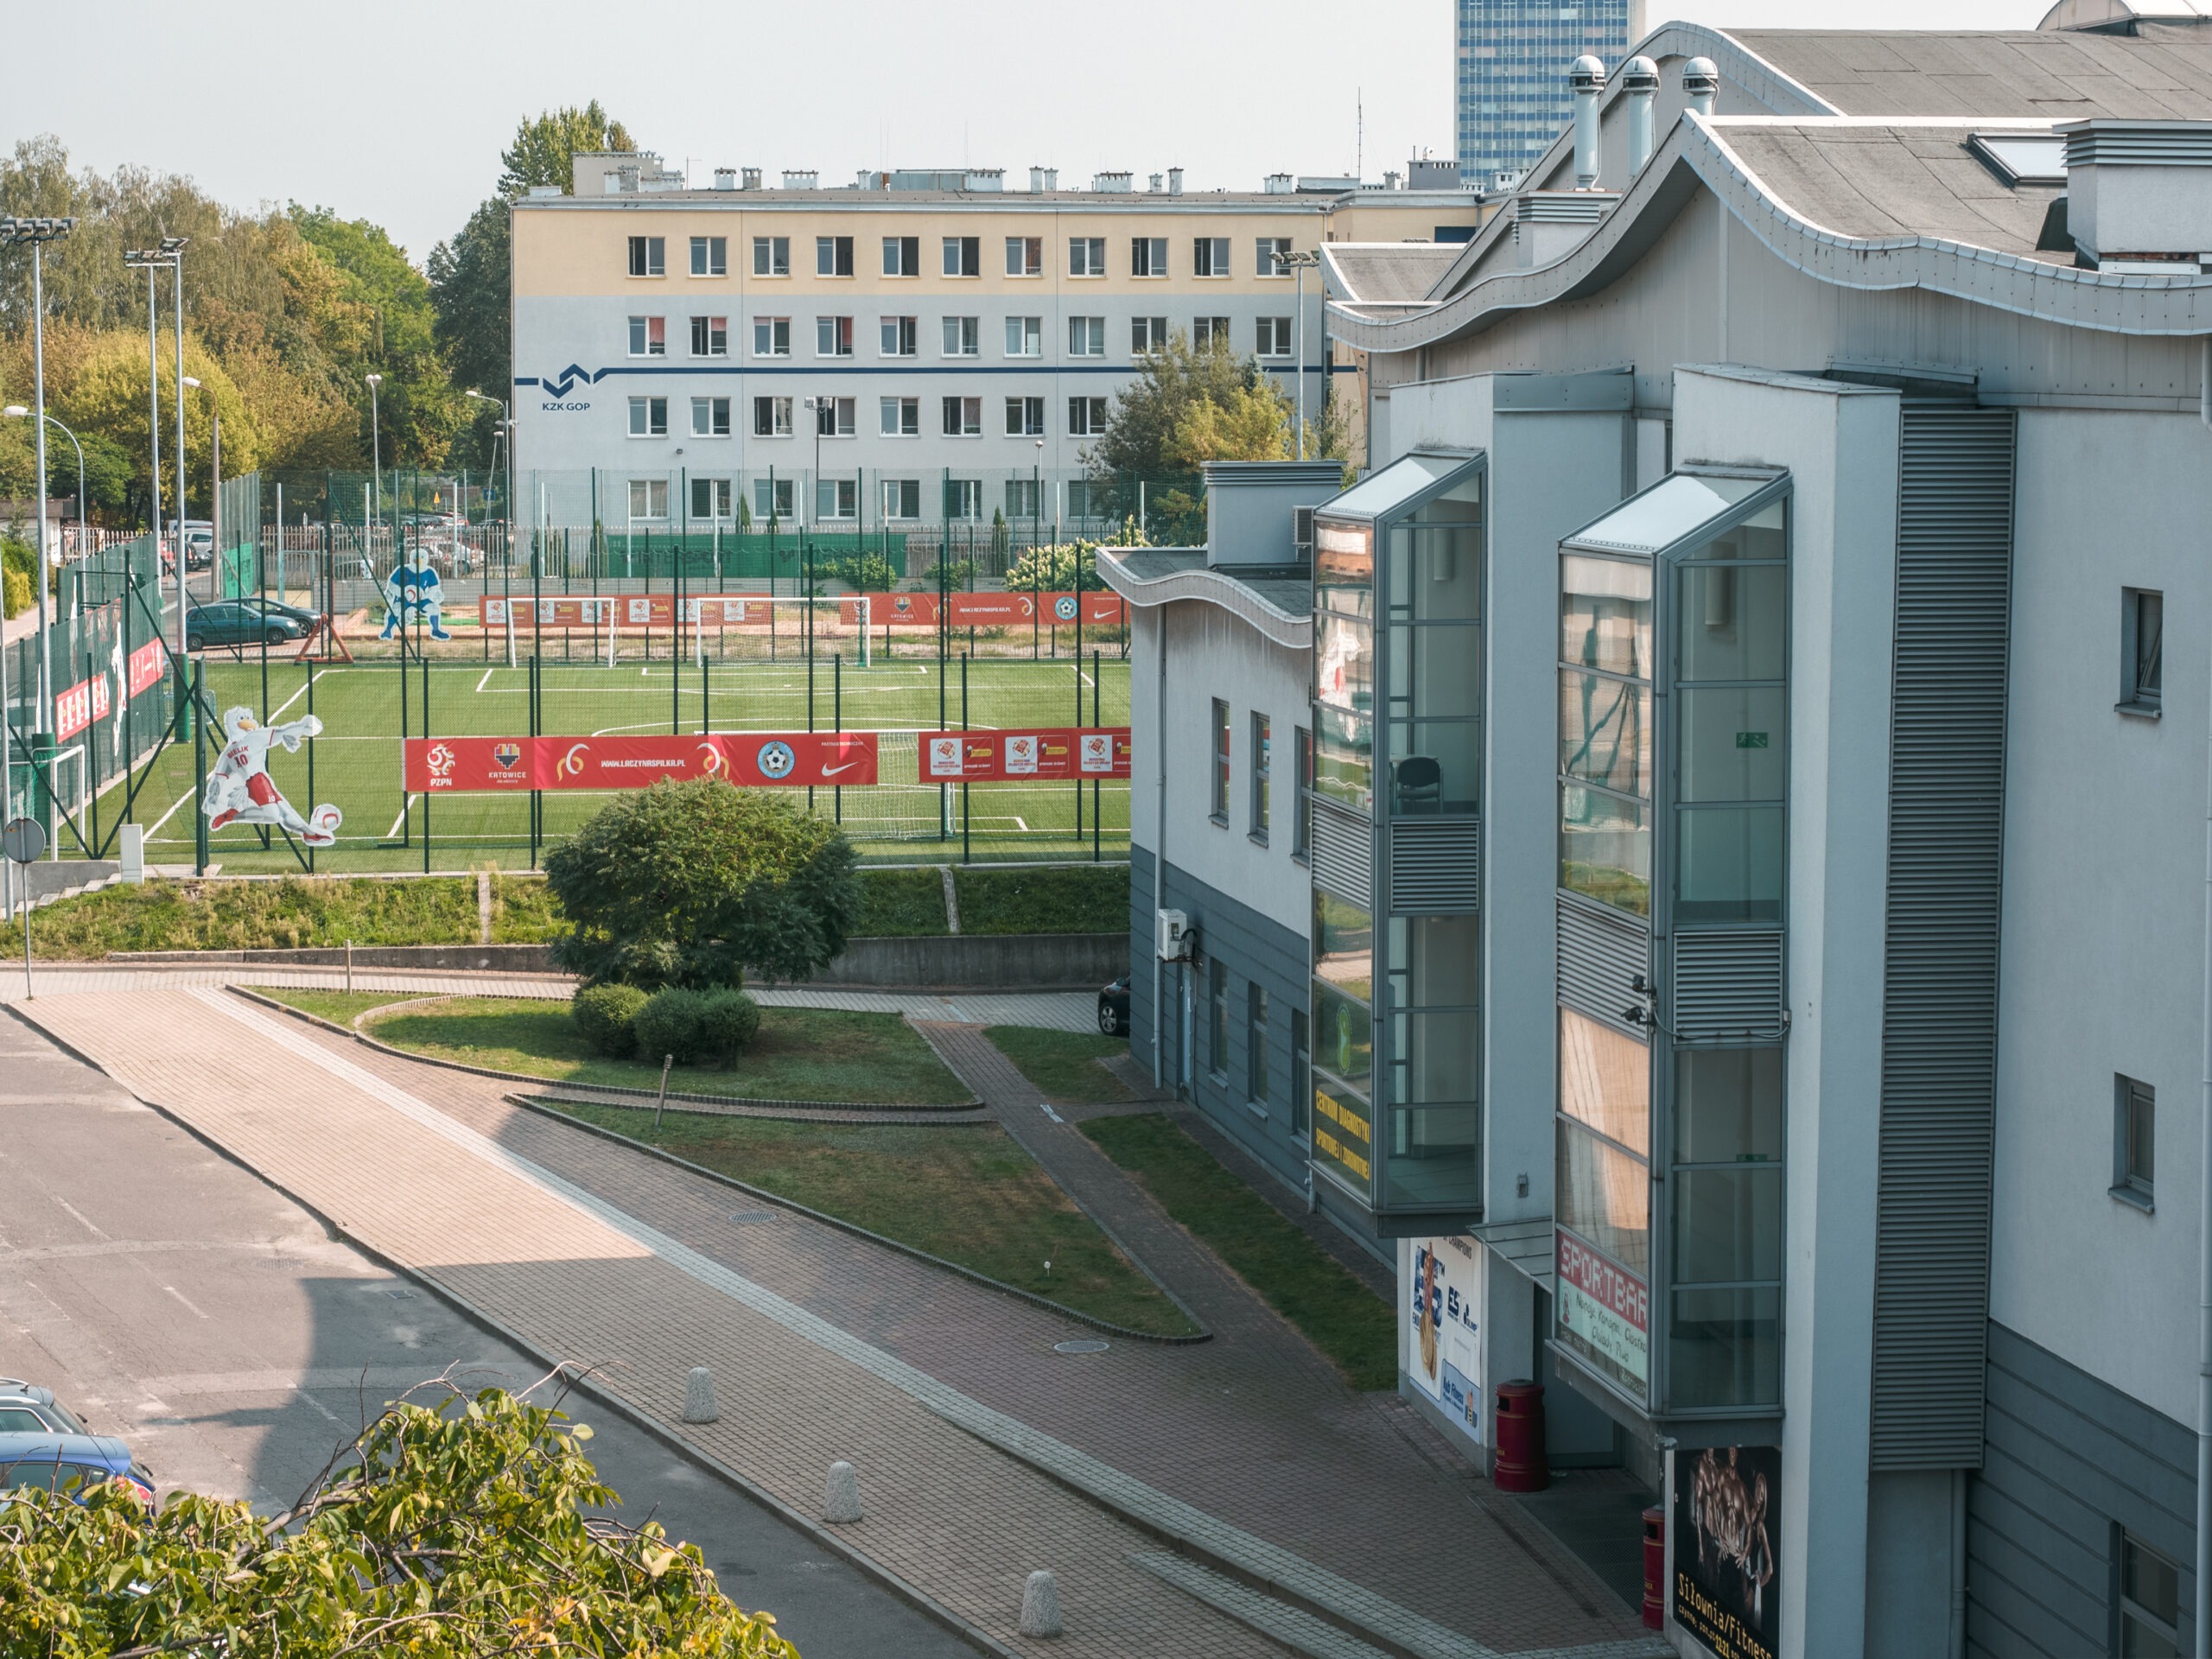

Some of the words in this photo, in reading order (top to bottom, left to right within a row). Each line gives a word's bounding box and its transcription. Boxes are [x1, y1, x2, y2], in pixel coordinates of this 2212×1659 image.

[542, 403, 564, 411] KZK
[566, 403, 591, 411] GOP
[226, 745, 249, 760] BIELIK
[234, 753, 249, 768] 10
[601, 759, 686, 767] WWW.LACZYNASPILKA.PL
[429, 778, 453, 786] PZPN
[268, 794, 276, 803] 10
[1316, 1088, 1338, 1123] CENTRUM
[1338, 1104, 1370, 1145] DIAGNOSTYKI
[1447, 1285, 1460, 1317] ES
